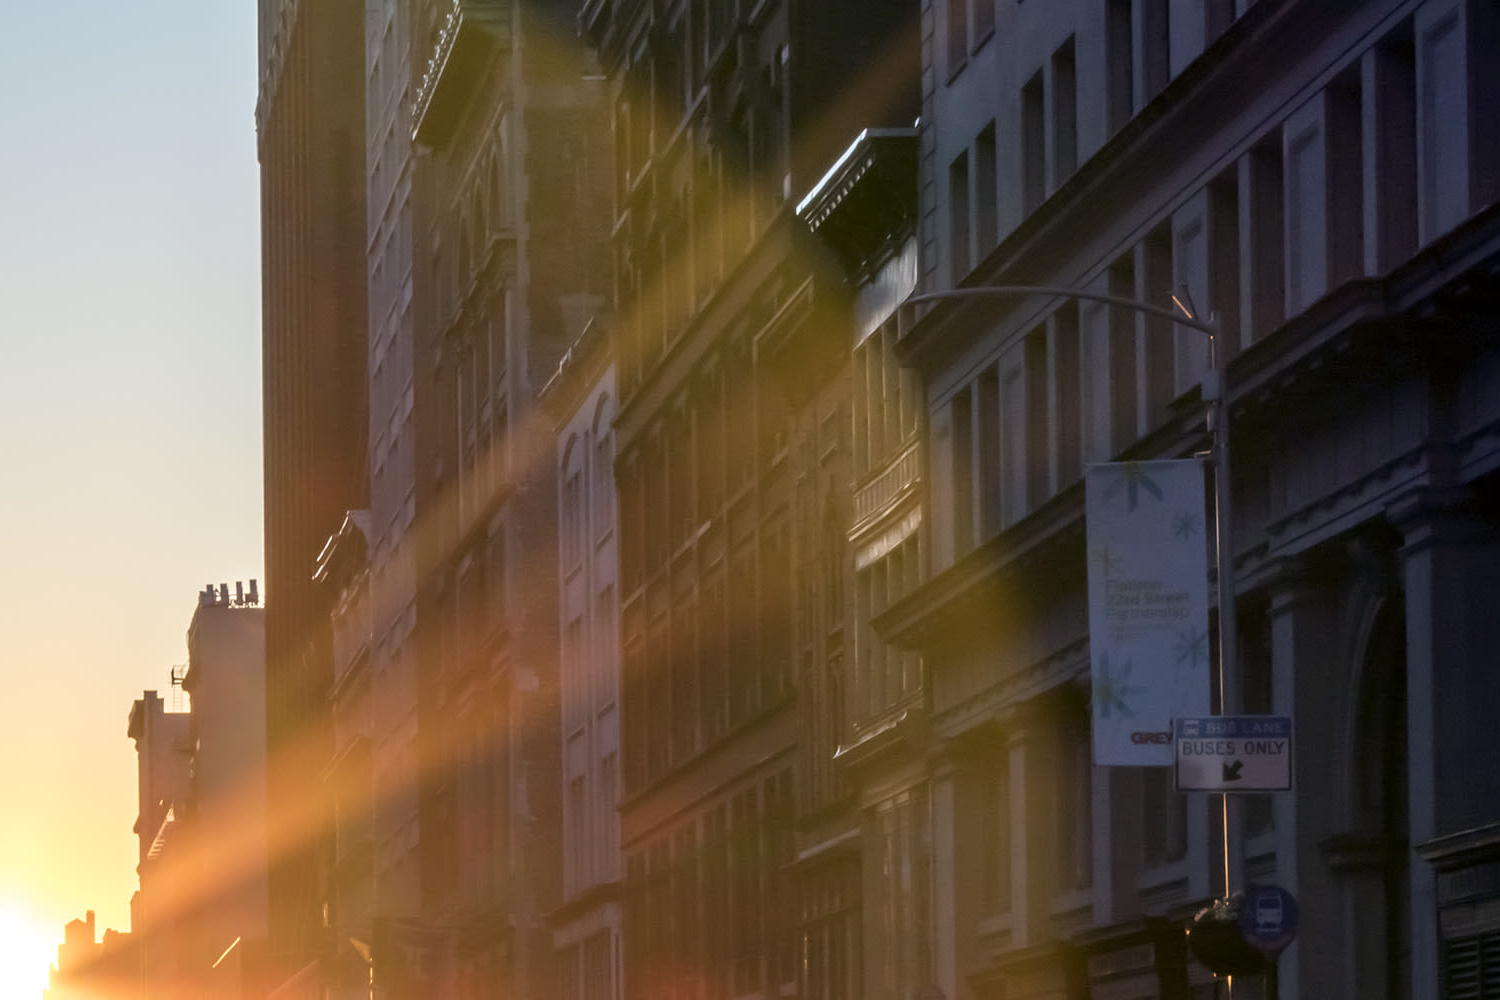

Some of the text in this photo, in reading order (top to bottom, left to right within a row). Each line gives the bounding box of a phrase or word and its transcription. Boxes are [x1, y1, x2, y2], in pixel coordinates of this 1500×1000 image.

[1206, 721, 1285, 734] BUS LANE
[1183, 740, 1285, 755] BUSES ONLY
